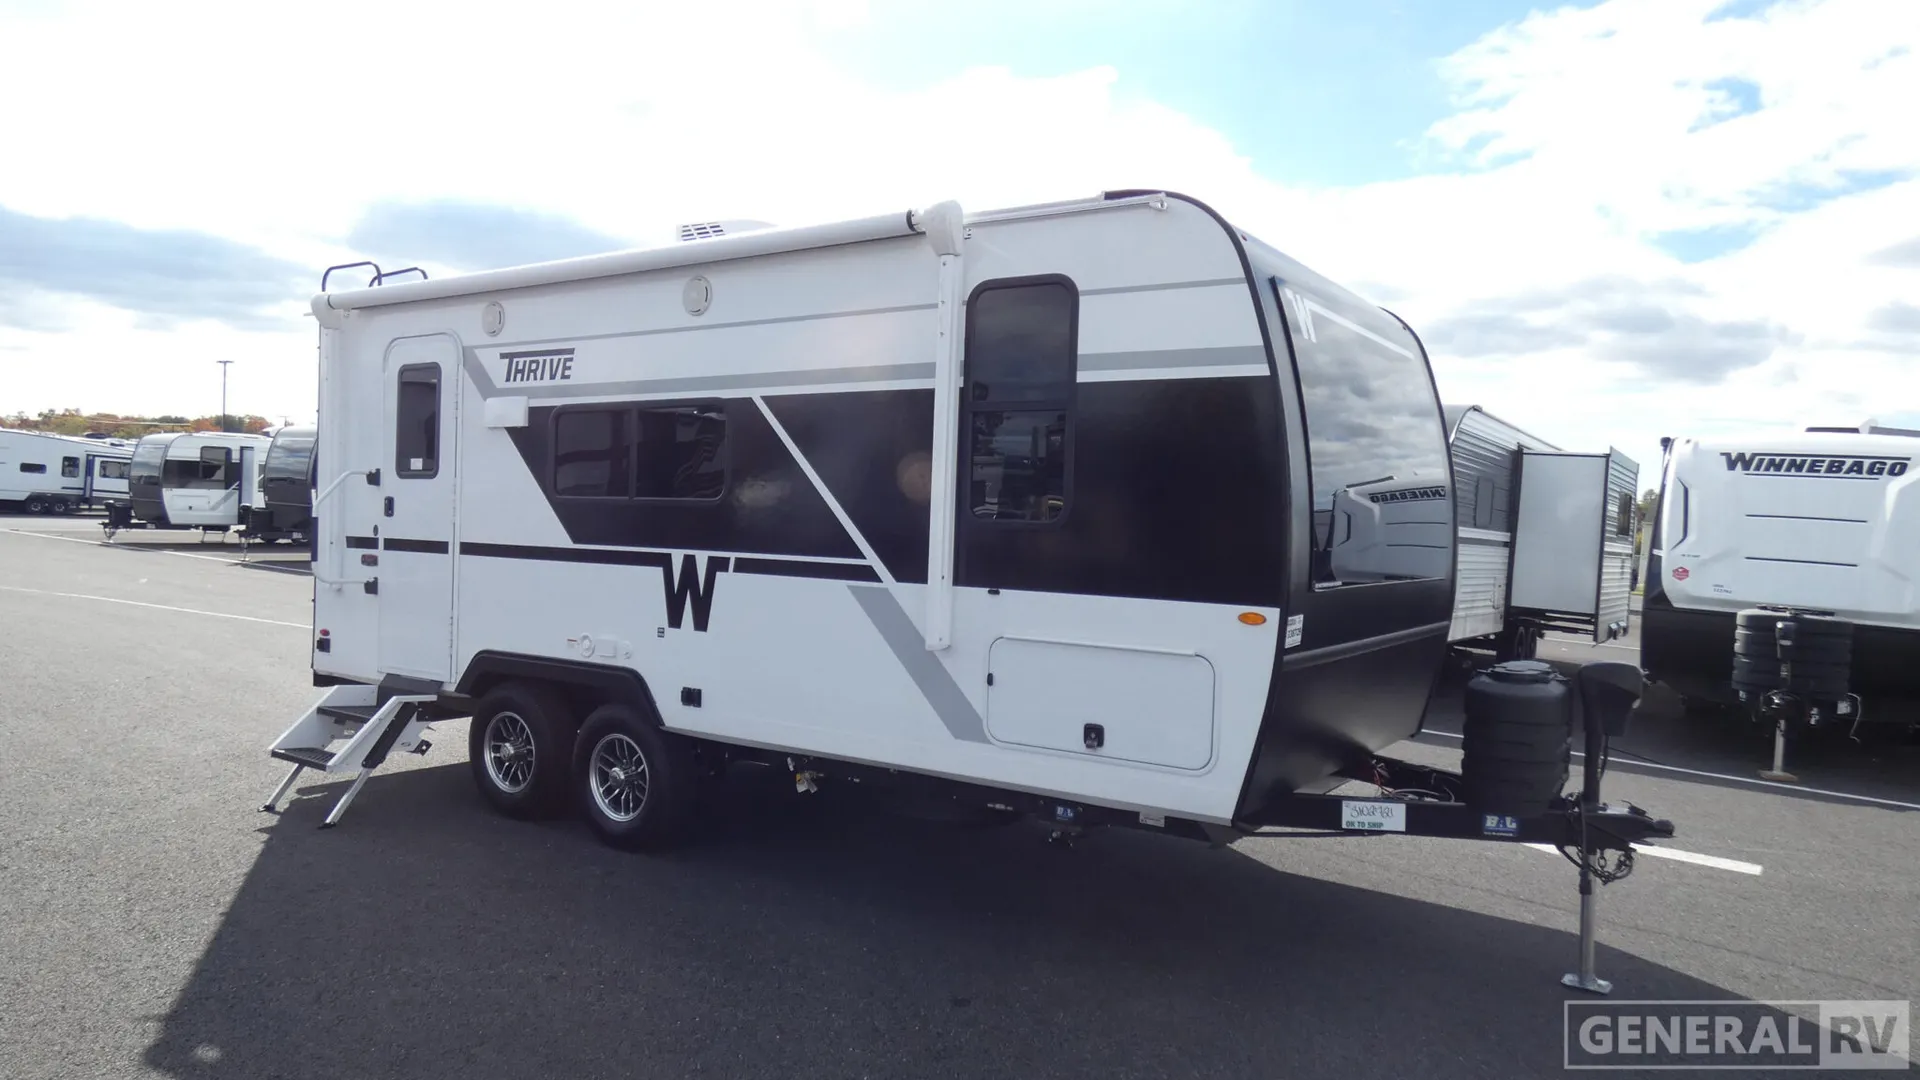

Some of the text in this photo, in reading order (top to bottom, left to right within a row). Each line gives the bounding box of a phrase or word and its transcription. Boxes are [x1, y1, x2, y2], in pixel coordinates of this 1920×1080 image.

[499, 347, 575, 383] THRIVE
[1719, 452, 1912, 477] WINNEBAGO
[658, 552, 731, 633] W
